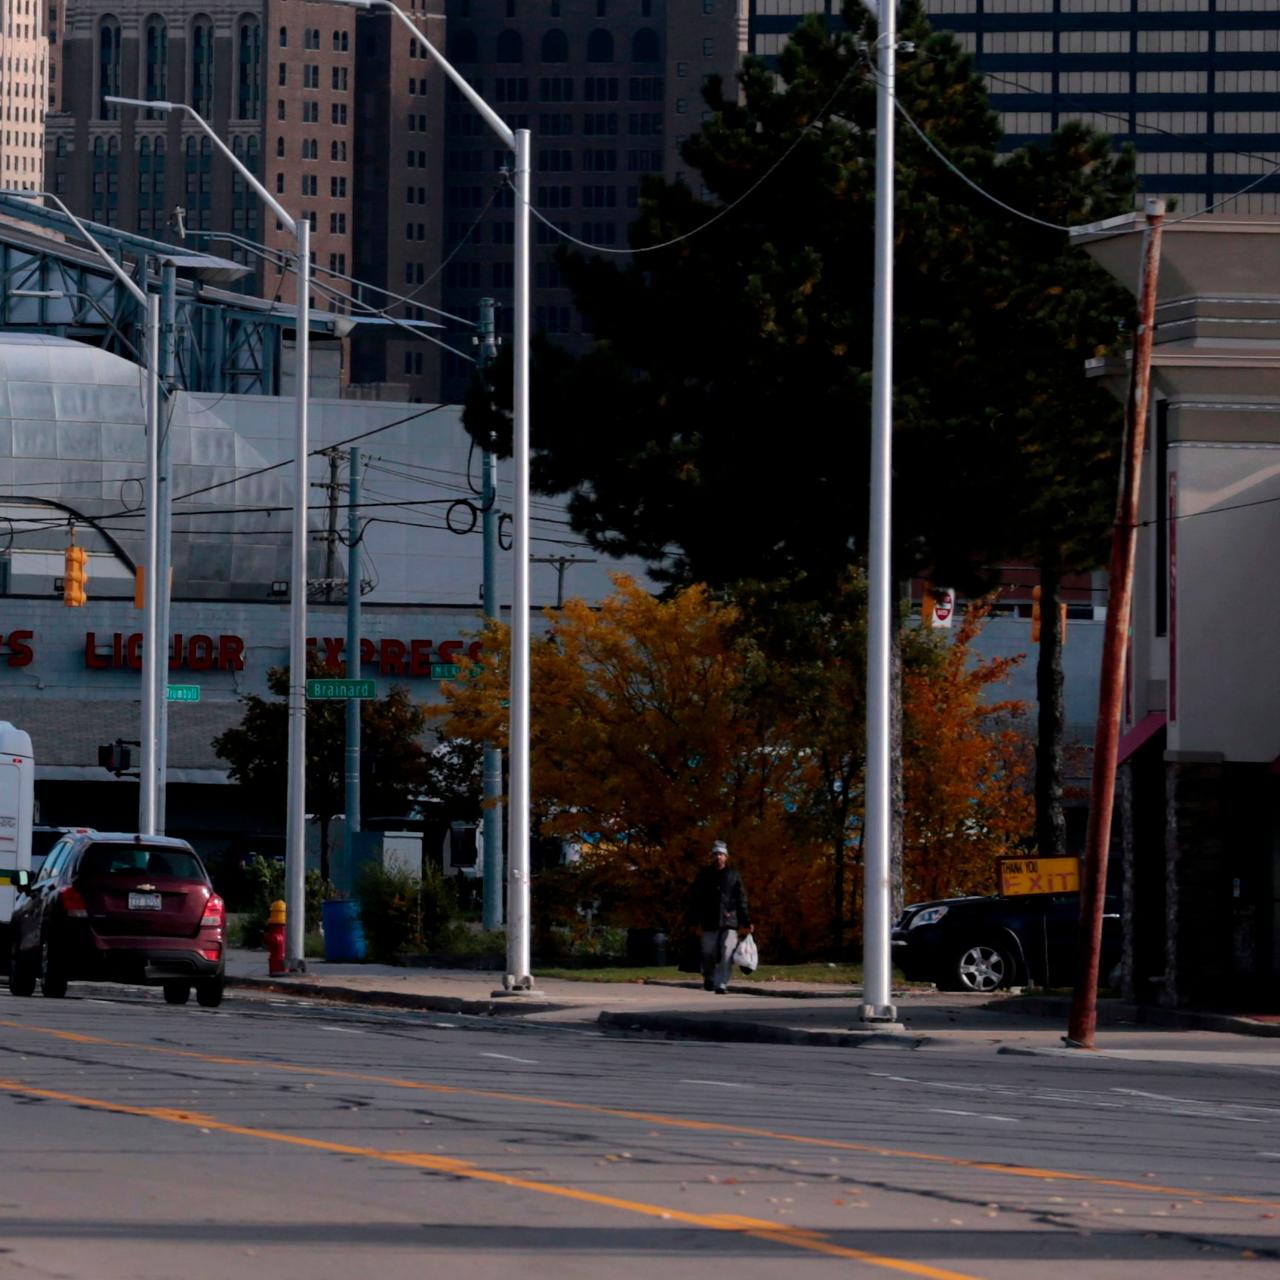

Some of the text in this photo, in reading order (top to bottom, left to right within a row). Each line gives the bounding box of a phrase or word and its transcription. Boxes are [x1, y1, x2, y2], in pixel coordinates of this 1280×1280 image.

[314, 683, 368, 697] Brainard
[1001, 861, 1039, 874] THANK YOU
